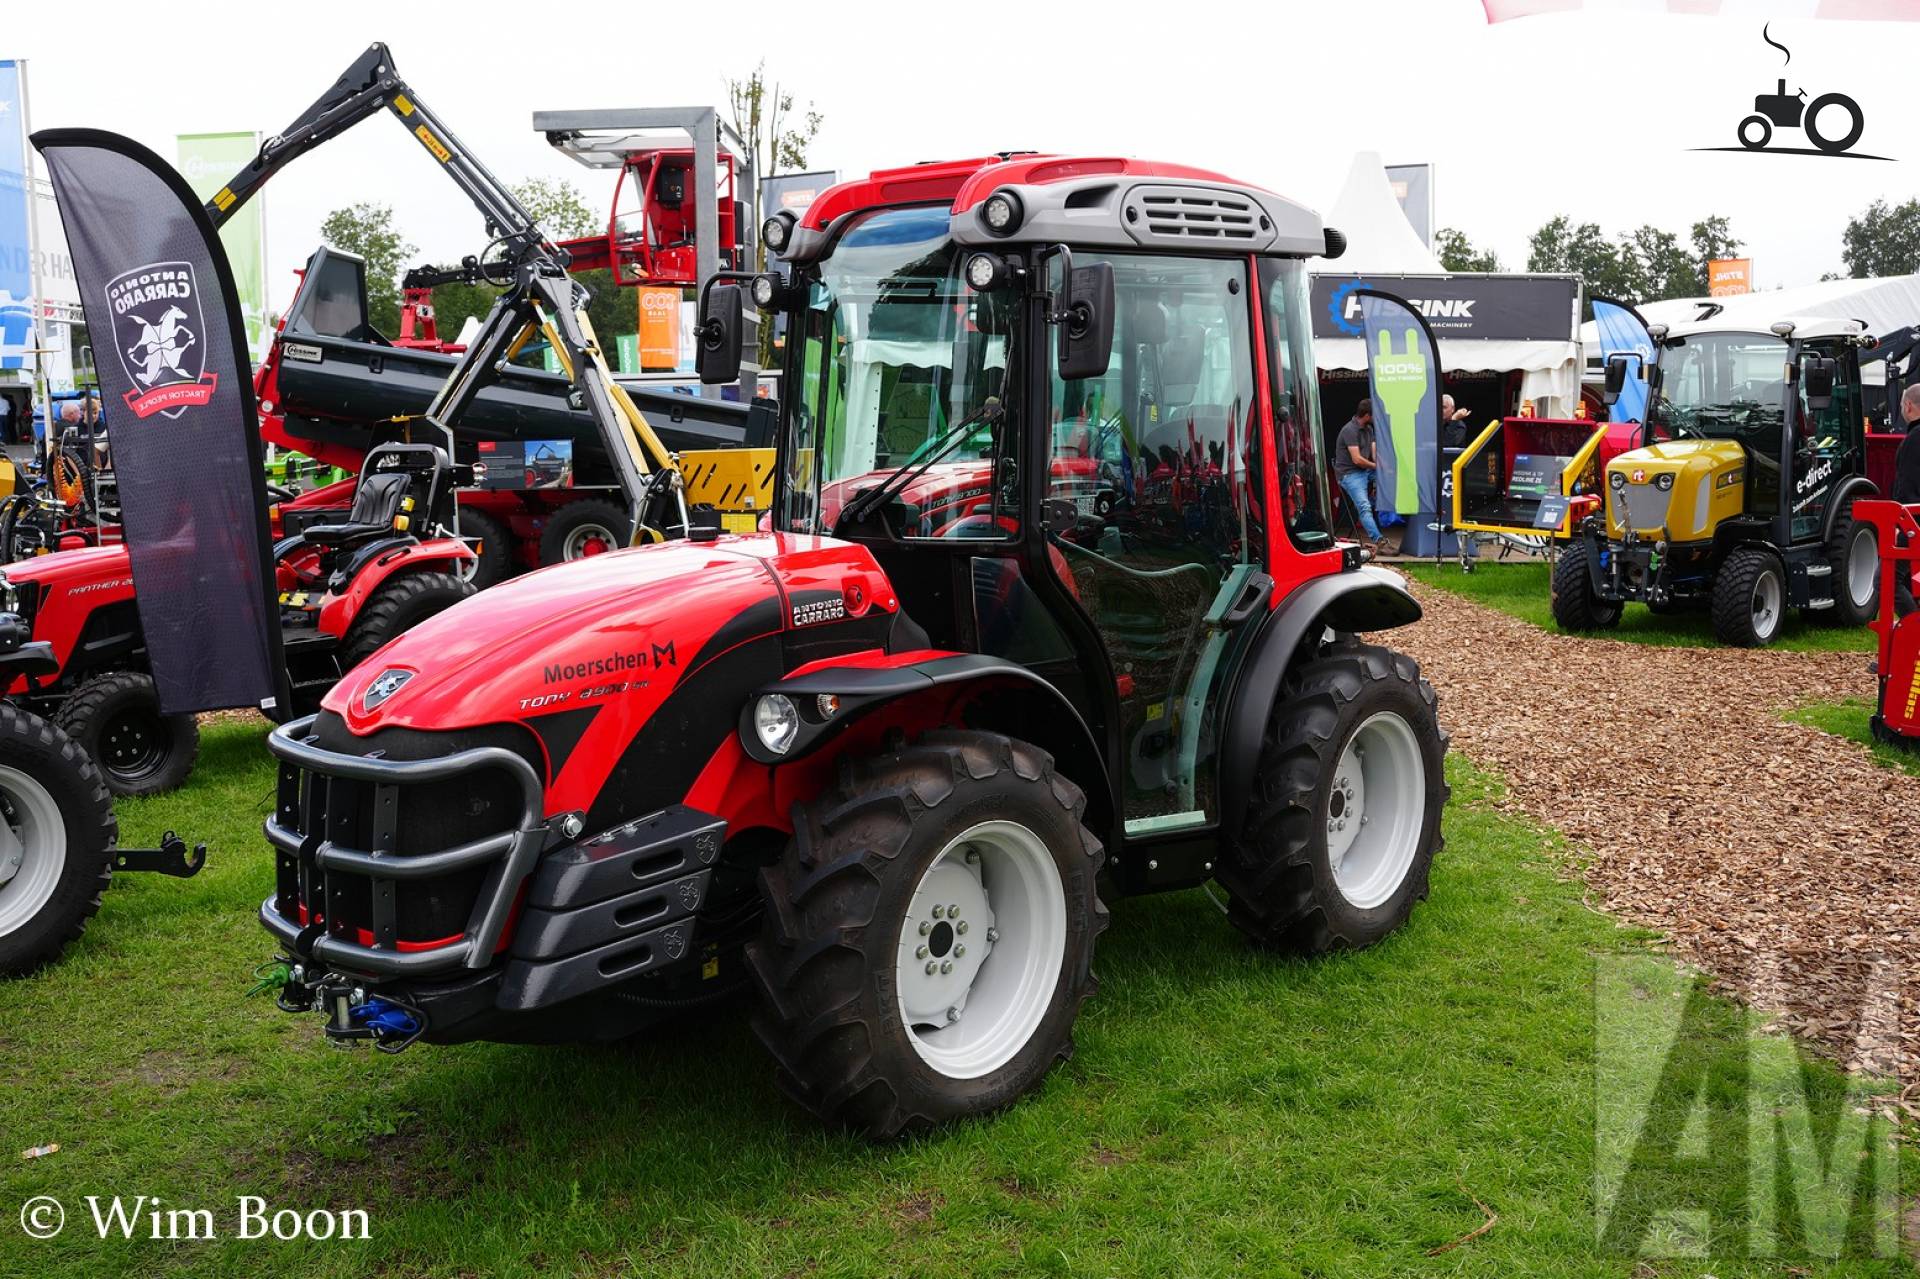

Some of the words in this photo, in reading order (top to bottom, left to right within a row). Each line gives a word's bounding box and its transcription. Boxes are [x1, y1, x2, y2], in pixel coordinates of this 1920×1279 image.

[1378, 362, 1423, 375] 100%
[1796, 459, 1832, 494] e-direct
[68, 580, 120, 596] PANTHER
[794, 598, 844, 615] ANTONIO
[794, 606, 845, 626] CARRARO
[544, 651, 647, 684] Moerschen
[519, 691, 572, 710] TONY
